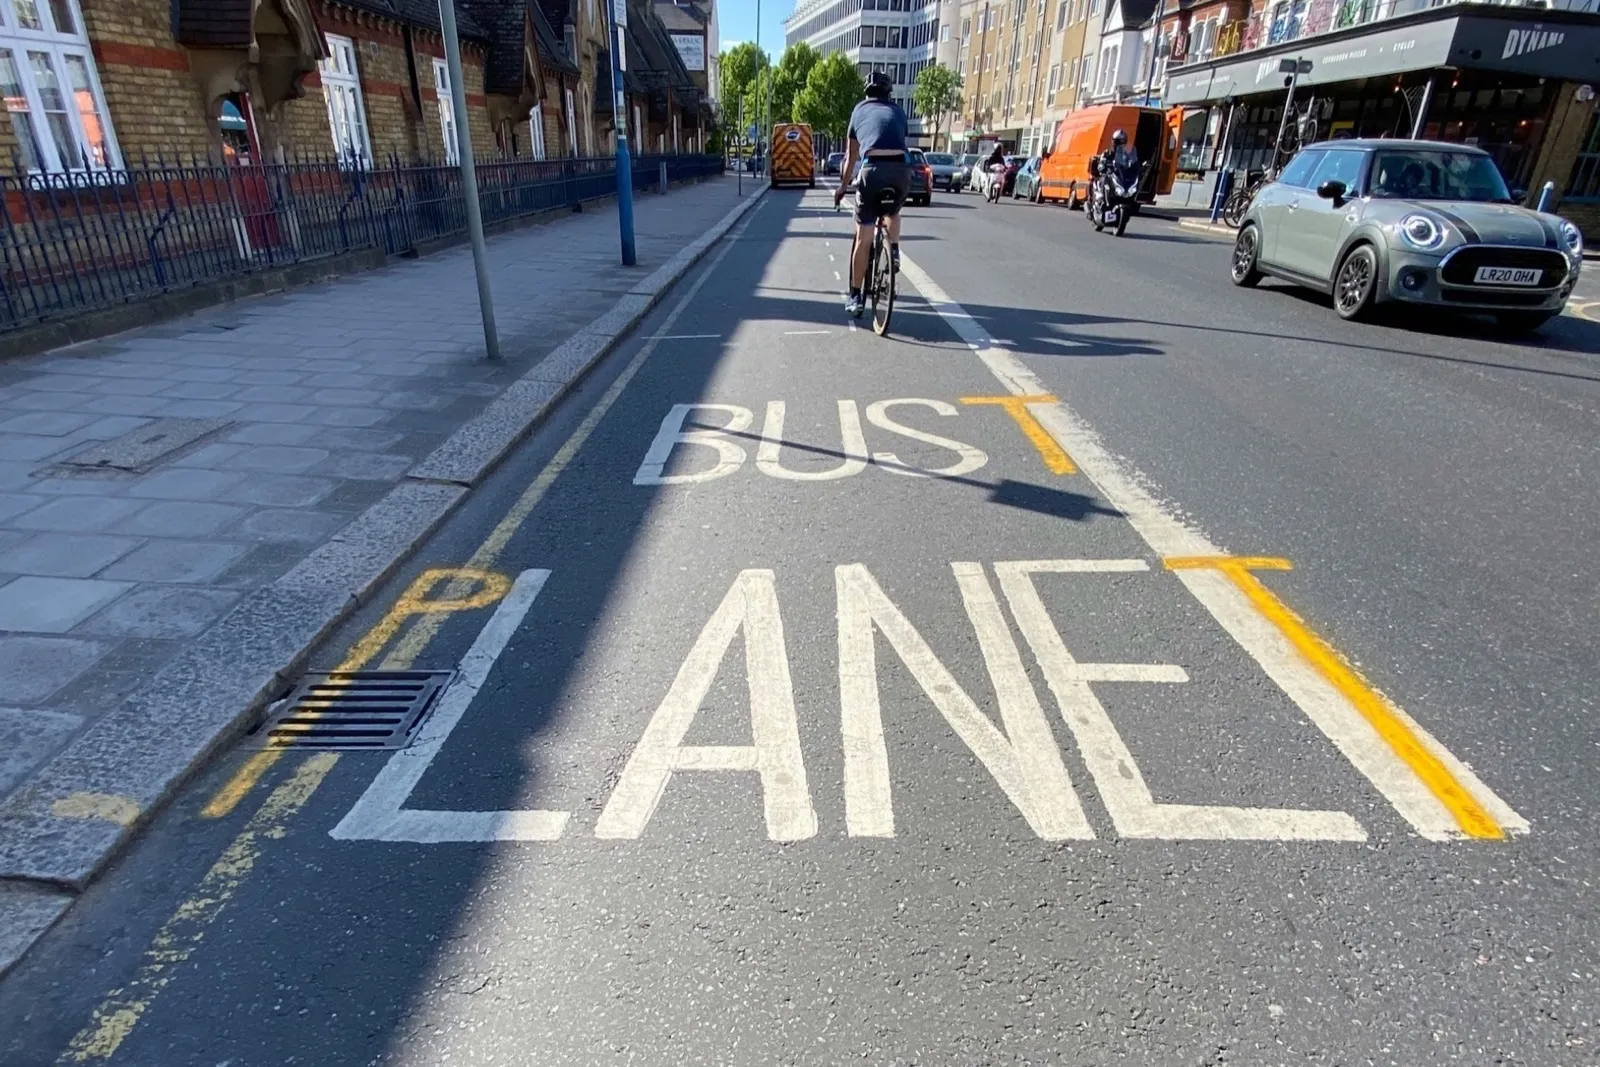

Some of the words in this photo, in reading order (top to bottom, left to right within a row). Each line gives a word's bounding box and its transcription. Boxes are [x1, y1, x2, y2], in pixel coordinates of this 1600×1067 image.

[1501, 28, 1565, 60] DYNAMO
[1480, 268, 1513, 281] LR20
[1513, 270, 1536, 283] OHA
